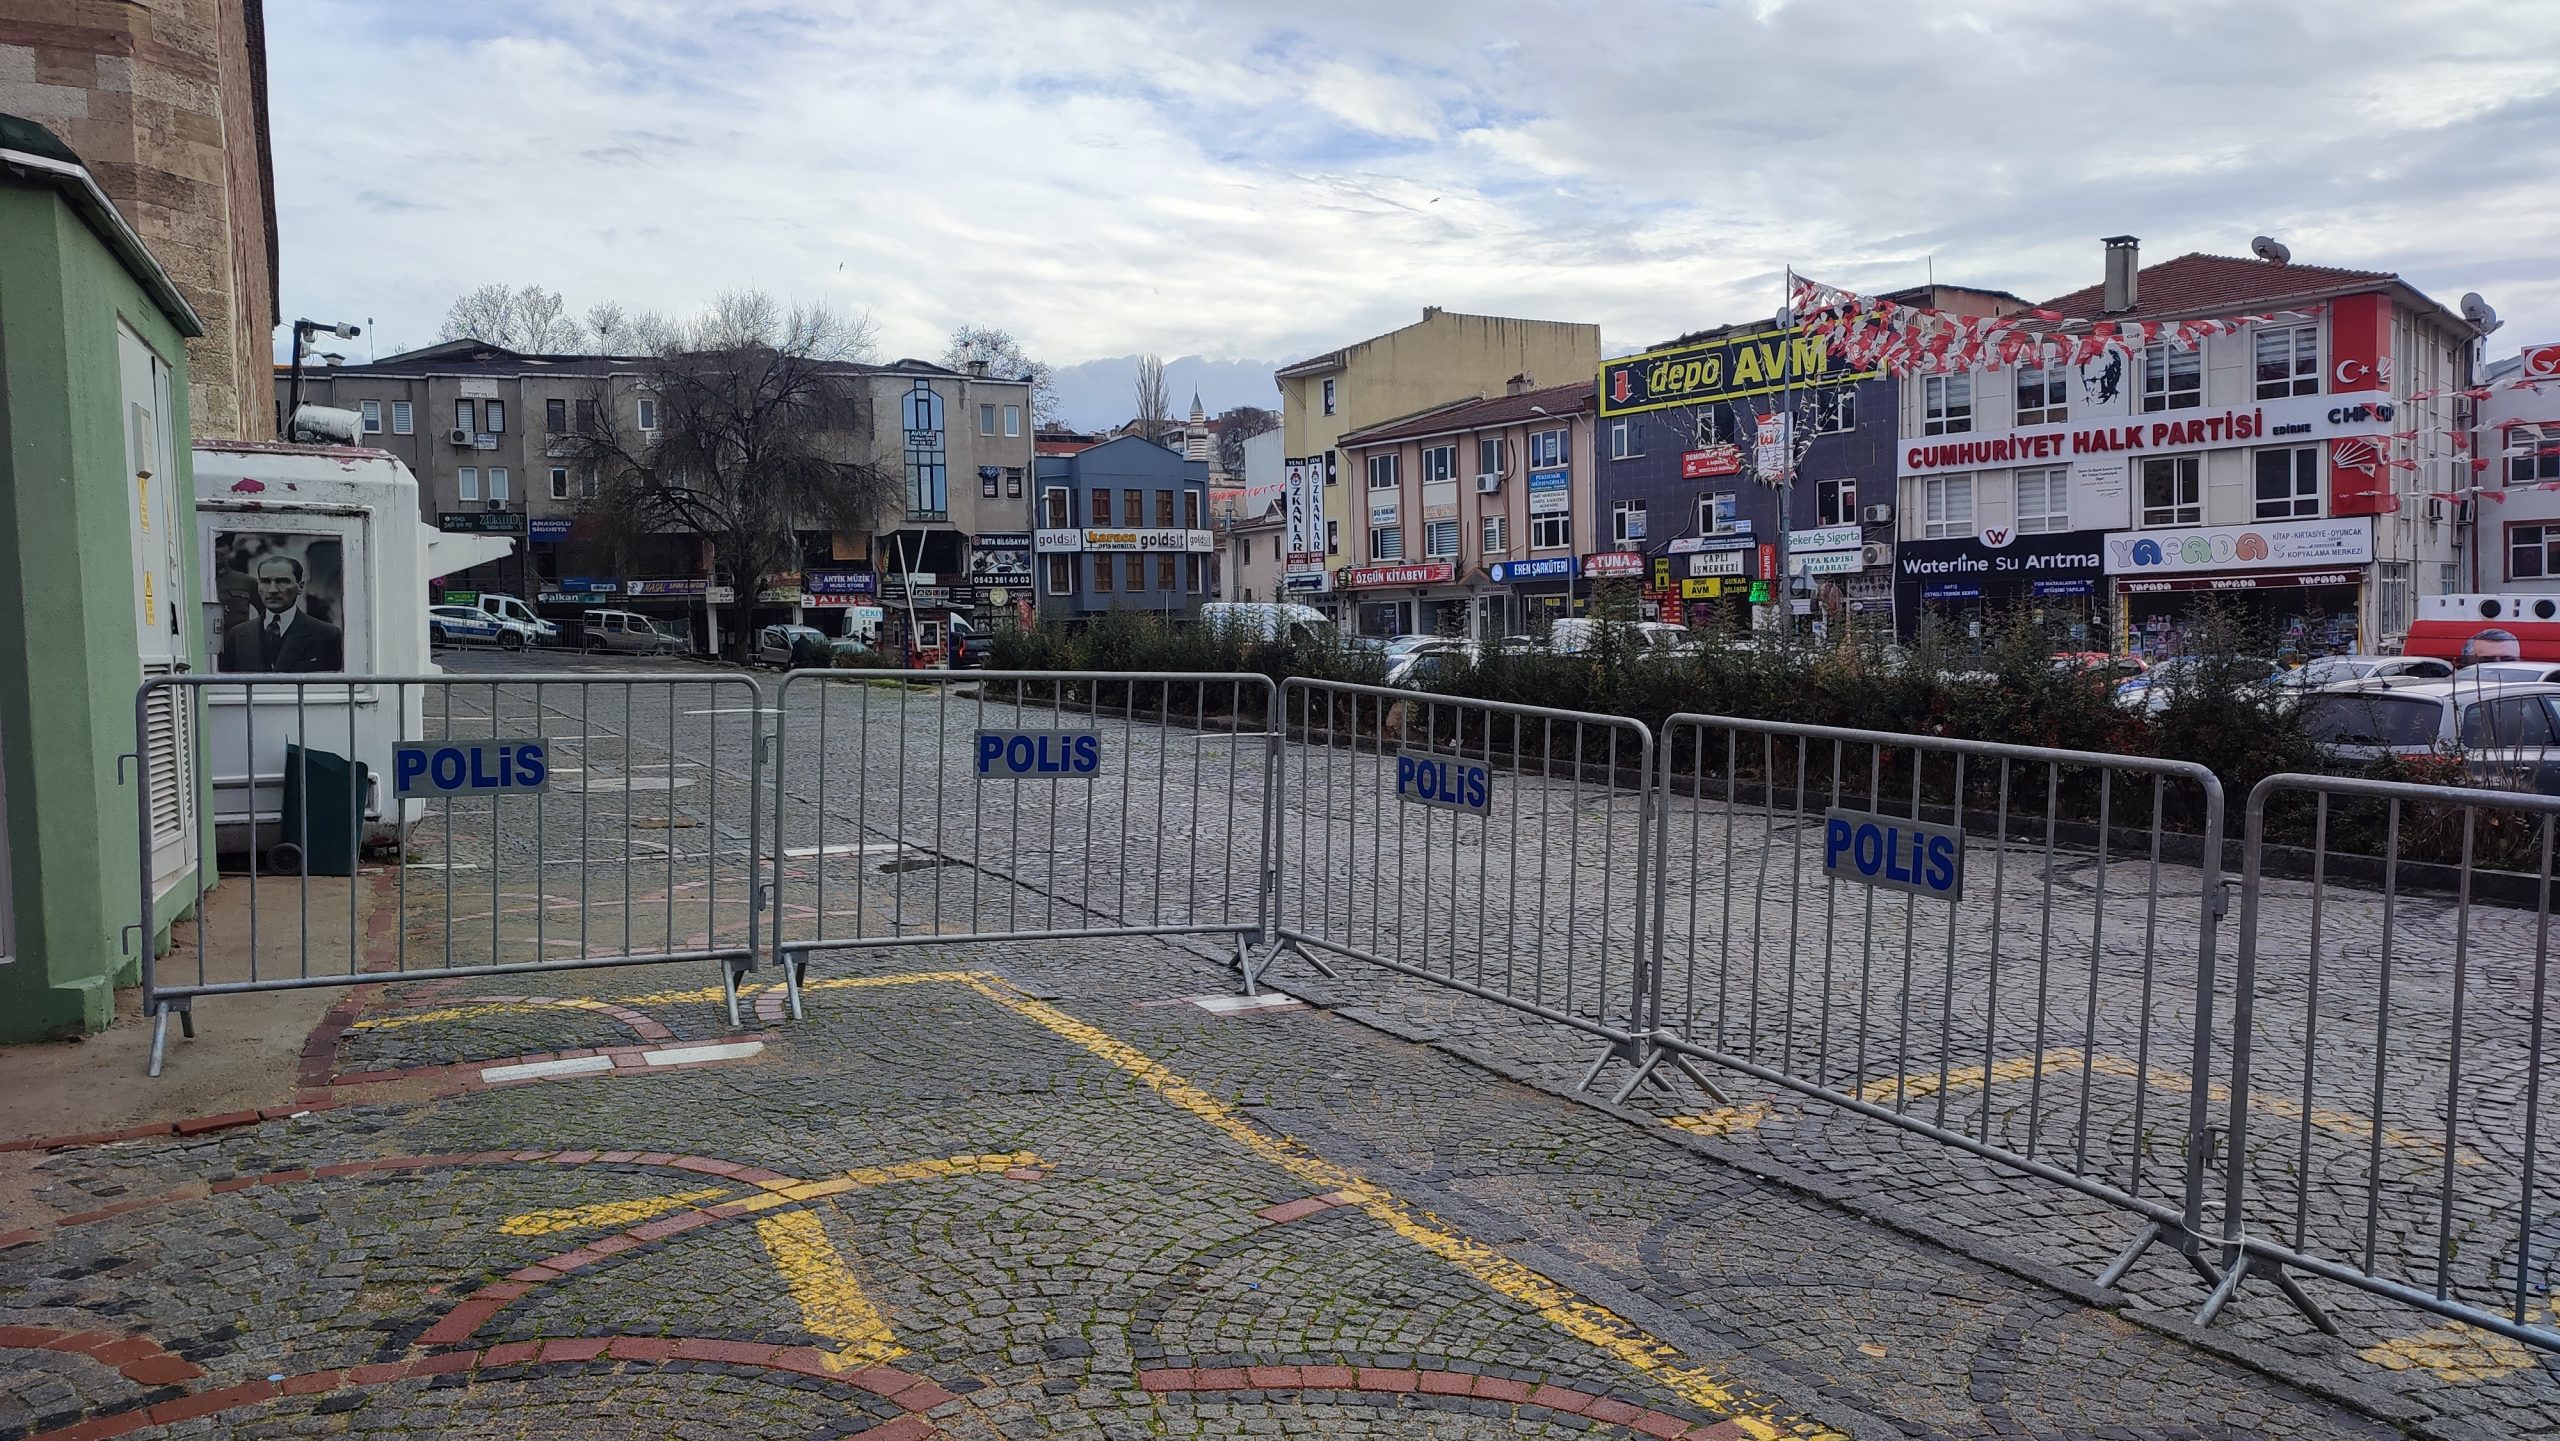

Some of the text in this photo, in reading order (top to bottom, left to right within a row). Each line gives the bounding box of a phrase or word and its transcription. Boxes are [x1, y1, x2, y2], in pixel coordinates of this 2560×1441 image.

[1650, 334, 1828, 392] depo AVM
[1907, 407, 2312, 469] CUMHURİYET HALK PARTİSİ EDİRNE
[1140, 532, 1184, 549] goldsit
[1826, 531, 1860, 545] Sigorta
[2272, 528, 2363, 541] KİTAP KIRTASİYE OYUNCAK
[981, 536, 1030, 546] BETA BİLGİSAYAR
[2287, 546, 2363, 558] KOPYALAMA MERKEZİ
[1597, 554, 1631, 569] TUNA
[1703, 553, 1728, 564] ÇAPLI
[1823, 555, 1854, 564] KAPISI
[1902, 552, 2100, 574] Waterline Su Arıtma
[1514, 558, 1568, 577] EREN ŞARKÜTERİ
[823, 573, 870, 583] ANTİK MÜZİK
[974, 576, 993, 584] 0542
[1008, 575, 1019, 584] 40
[1020, 575, 1030, 584] 02
[1356, 570, 1384, 584] ÖZGÜN
[1386, 566, 1427, 582] KİTABEVİ
[2298, 574, 2347, 585] YAPADA
[2129, 582, 2172, 591] YAPADA
[2210, 579, 2257, 588] YAPADA
[1691, 586, 1709, 594] AVM
